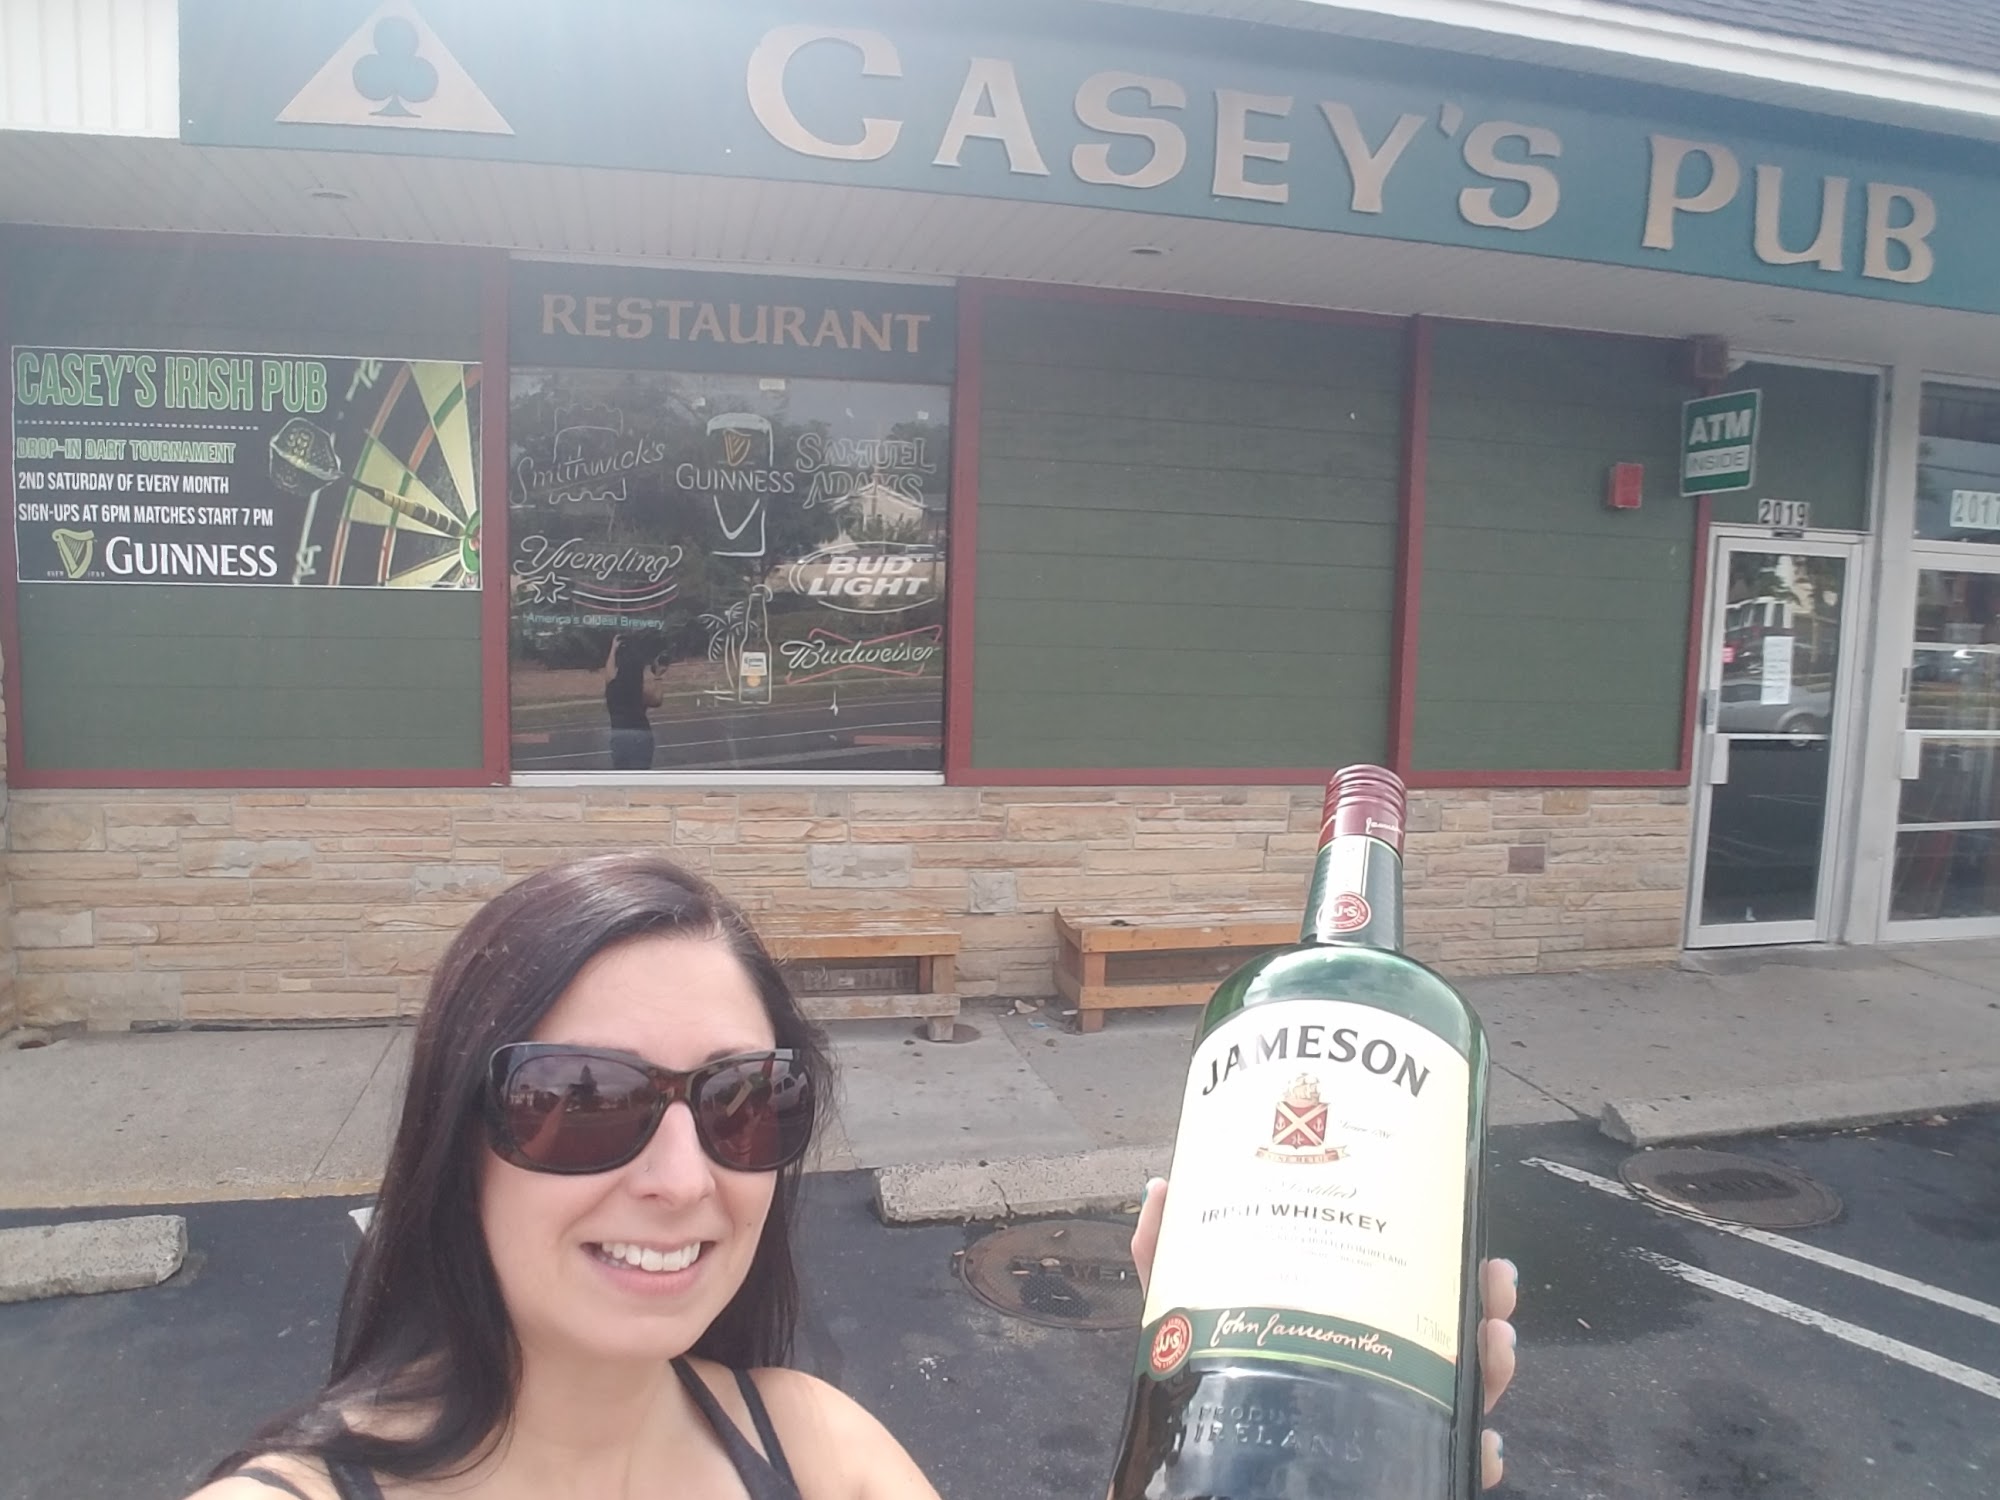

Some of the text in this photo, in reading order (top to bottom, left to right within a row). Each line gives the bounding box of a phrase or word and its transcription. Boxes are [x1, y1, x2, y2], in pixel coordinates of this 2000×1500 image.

[746, 24, 1937, 284] CASEY'S PUB
[541, 293, 931, 353] RESTAURANT
[16, 352, 157, 408] CASEY'S
[165, 357, 253, 411] IRISH
[262, 361, 328, 413] PUB
[1688, 408, 1753, 446] ATM
[17, 437, 236, 464] DROP-IN DART TOURNAMENT
[796, 431, 937, 474] SAMUEL
[1687, 451, 1746, 471] INSIDE
[18, 471, 230, 494] 2ND SATURDAY OF EVERY MONTH
[510, 437, 666, 506] Smithwick's
[675, 462, 796, 494] GUINNESS
[802, 471, 925, 509] ADAMS
[18, 503, 274, 527] SIGN-UPS AT 6PM MATCHES START 7 PM
[1760, 500, 1807, 527] 2019
[105, 536, 278, 577] GUINNESS
[513, 535, 684, 582] Yuengling
[826, 556, 914, 575] BUD
[807, 577, 930, 596] LIGHT
[620, 616, 665, 630] Brewery
[780, 639, 941, 669] Budweiser
[1202, 1025, 1431, 1097] JAMESON
[1271, 1203, 1388, 1234] WHISKEY
[1209, 1310, 1259, 1347] John
[1256, 1313, 1356, 1349] Jameson
